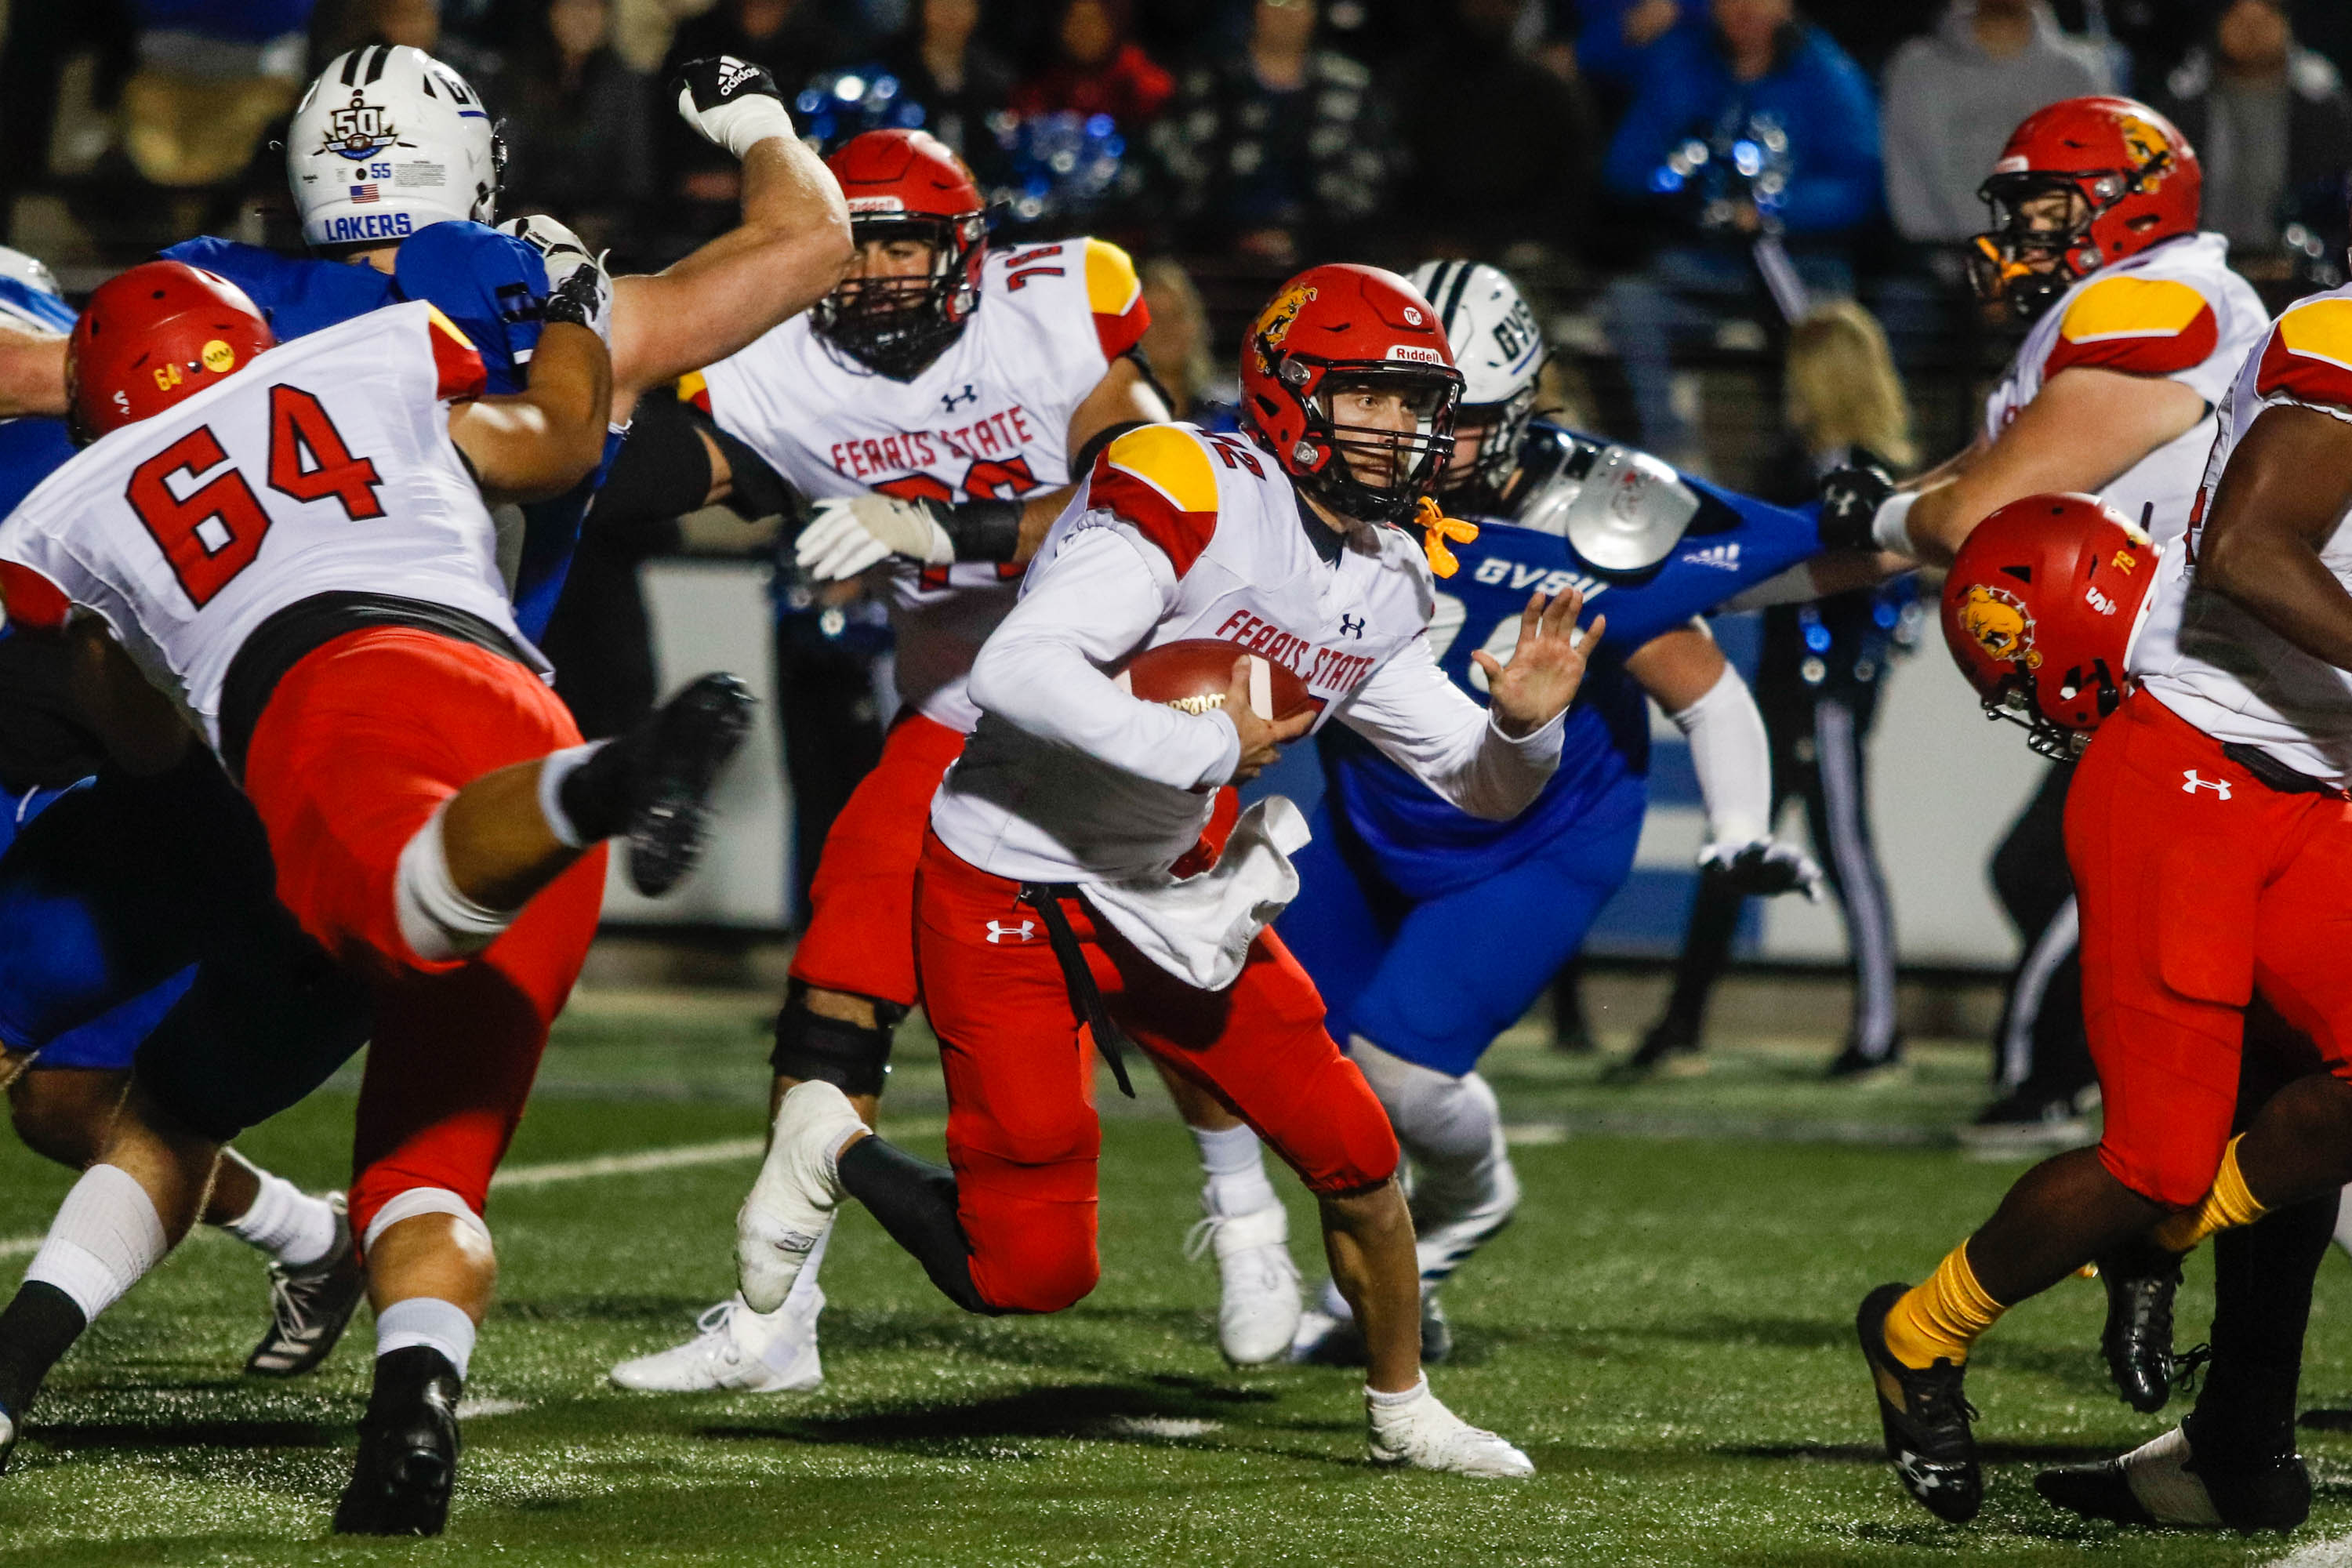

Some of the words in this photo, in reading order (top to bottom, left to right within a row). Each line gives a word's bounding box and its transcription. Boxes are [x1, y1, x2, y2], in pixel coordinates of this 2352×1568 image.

[720, 67, 760, 96] adidas
[335, 107, 382, 140] 50
[370, 162, 391, 179] 55
[324, 212, 412, 241] LAKERS
[1396, 348, 1439, 363] Riddell
[154, 363, 183, 391] 64
[831, 433, 936, 477] FERRIS
[1194, 429, 1268, 482] 12
[125, 382, 387, 612] 64
[2111, 550, 2136, 576] 78
[1214, 609, 1310, 674] FERRIS
[1305, 647, 1375, 693] STATE
